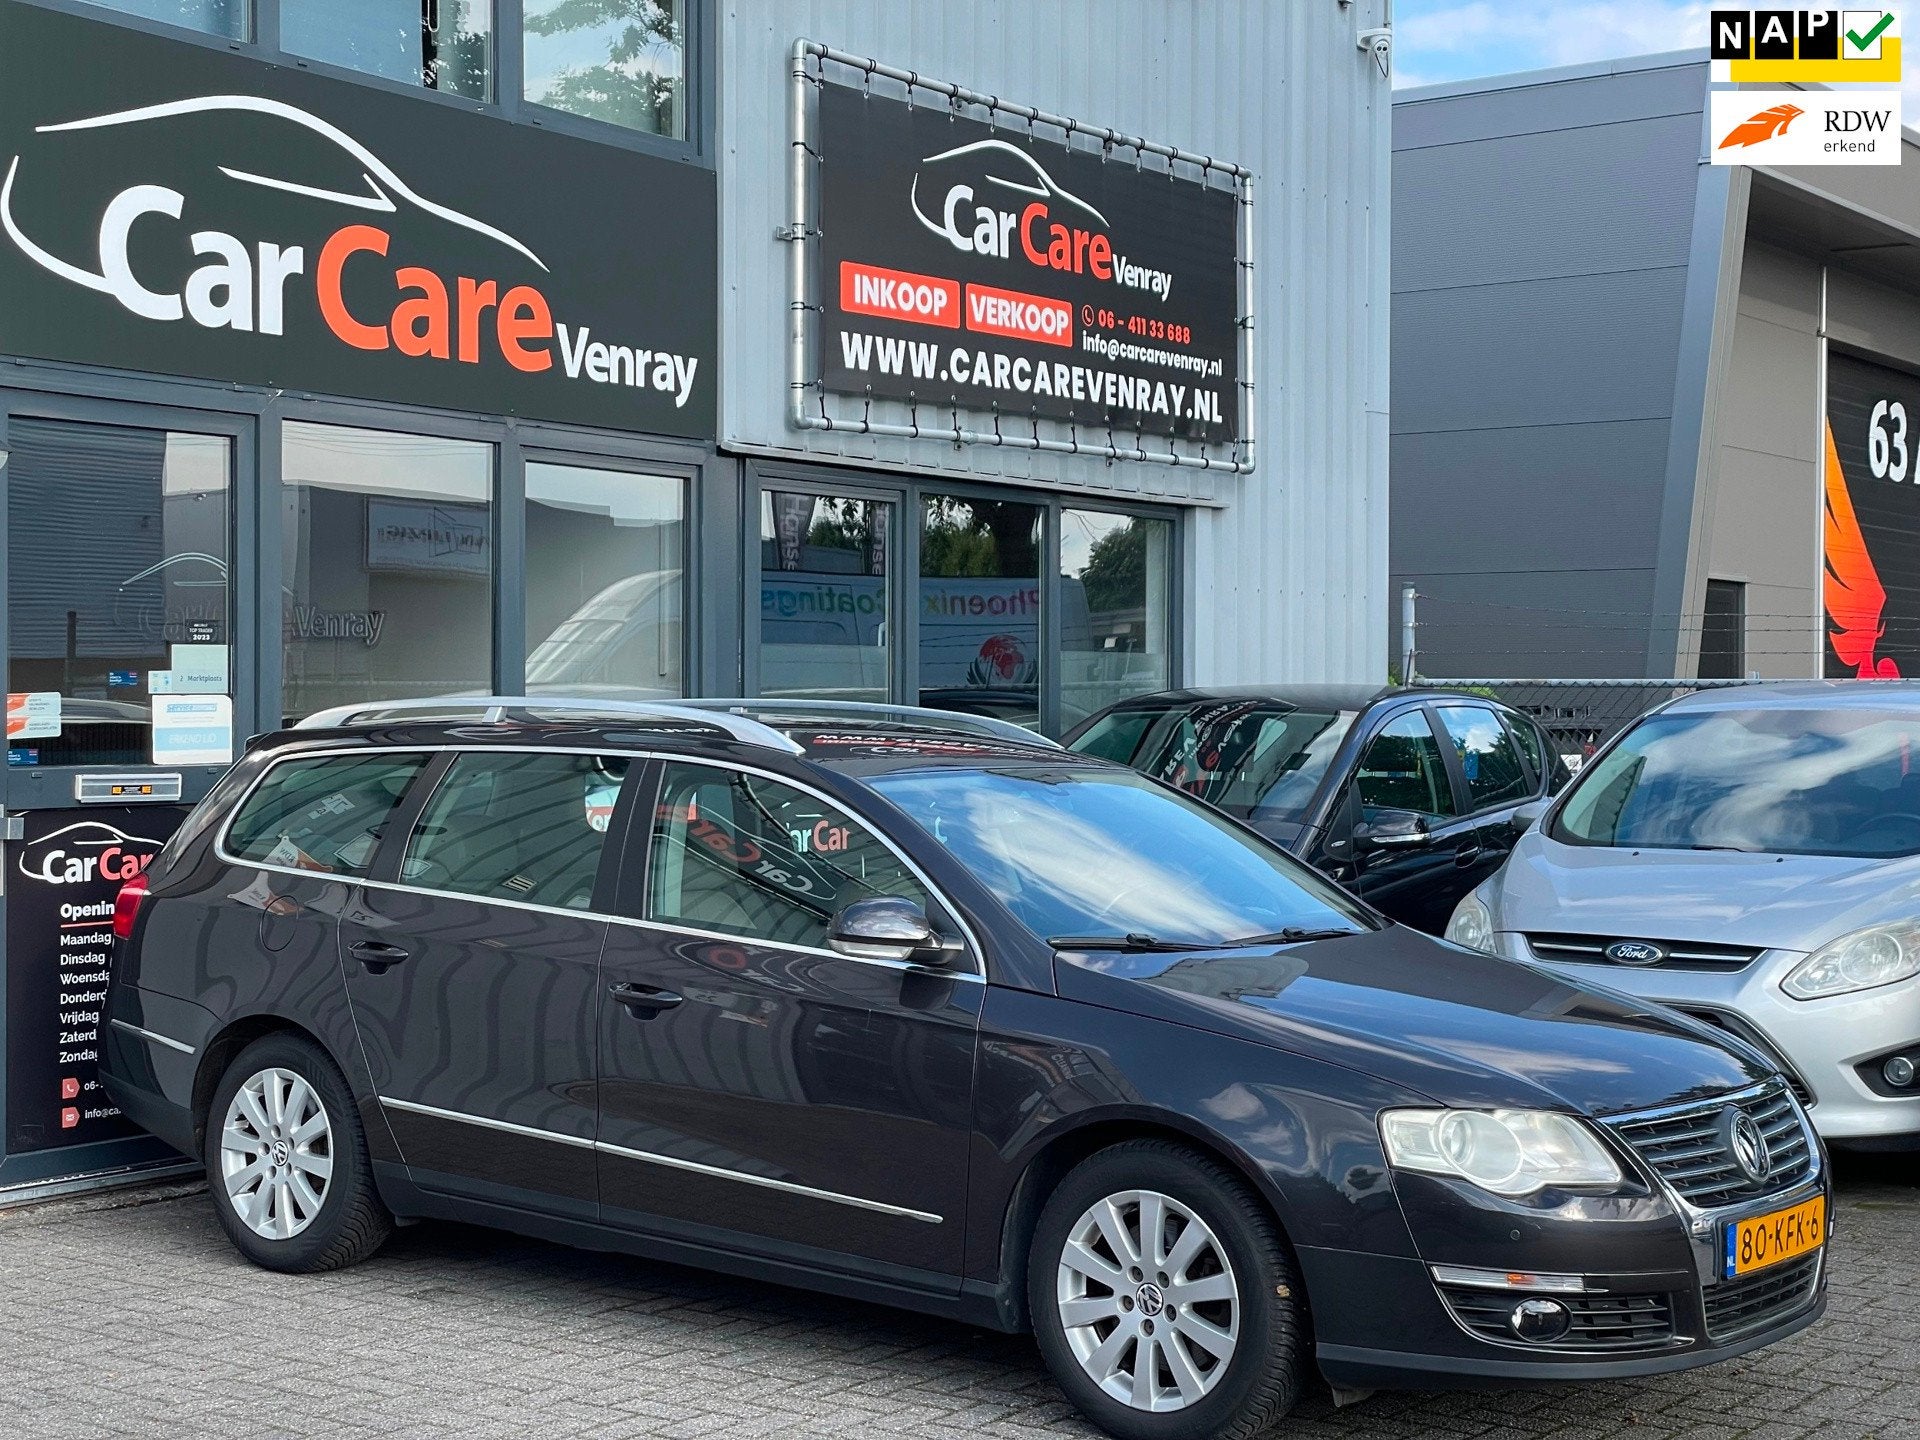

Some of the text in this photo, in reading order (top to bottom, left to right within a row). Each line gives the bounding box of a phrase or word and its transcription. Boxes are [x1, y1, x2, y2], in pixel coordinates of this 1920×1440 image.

[854, 274, 948, 317] INKOOP
[1112, 253, 1172, 302] Venray
[970, 293, 1069, 338] VERKOOP
[1098, 309, 1115, 329] 06
[1127, 316, 1146, 336] 411
[1149, 320, 1164, 339] 33
[1167, 323, 1191, 345] 688
[556, 323, 698, 407] Venray
[1082, 330, 1223, 379] info@carcarevenray.nl
[840, 332, 1223, 424] WWW.CARCAREVENRAY.NL
[295, 606, 385, 645] Venray
[60, 900, 115, 921] Openin
[60, 932, 112, 947] Maandag
[1617, 944, 1649, 959] Ford
[60, 952, 105, 966] Dinsdag
[60, 1011, 99, 1025] Vrijdag
[60, 1029, 97, 1044] Zaterd
[1741, 1204, 1819, 1265] 80-KFK-6
[1726, 1255, 1736, 1268] NL
